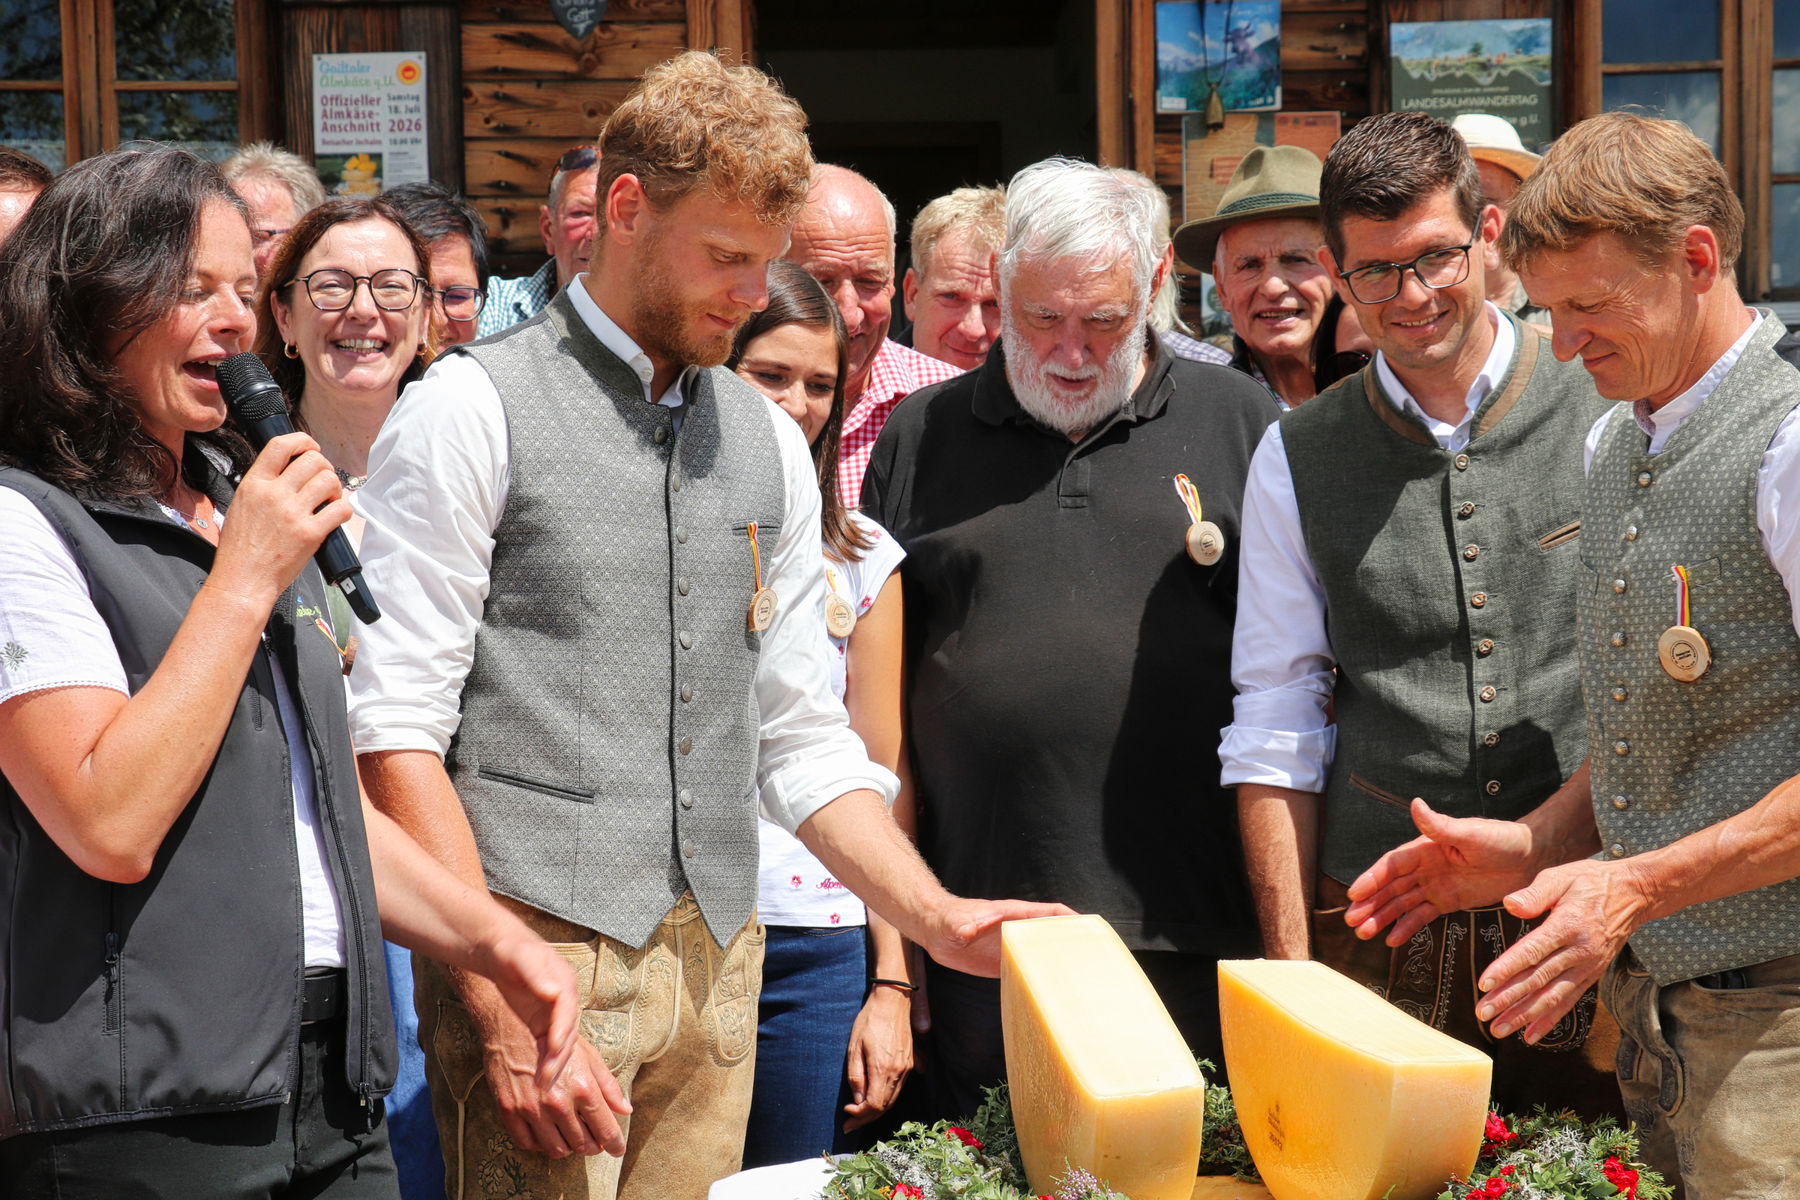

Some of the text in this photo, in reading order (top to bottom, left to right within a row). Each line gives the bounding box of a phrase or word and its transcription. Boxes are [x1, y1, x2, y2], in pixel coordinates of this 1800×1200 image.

[321, 95, 382, 107] Offizieller
[387, 93, 420, 103] Samstag
[1401, 94, 1538, 110] LANDESALMWANDERTAG
[321, 107, 380, 120] Almkäse-
[388, 104, 421, 115] 18. Juli
[321, 121, 381, 133] Anschnitt
[388, 118, 422, 133] 2026
[815, 877, 843, 892] Alpen
